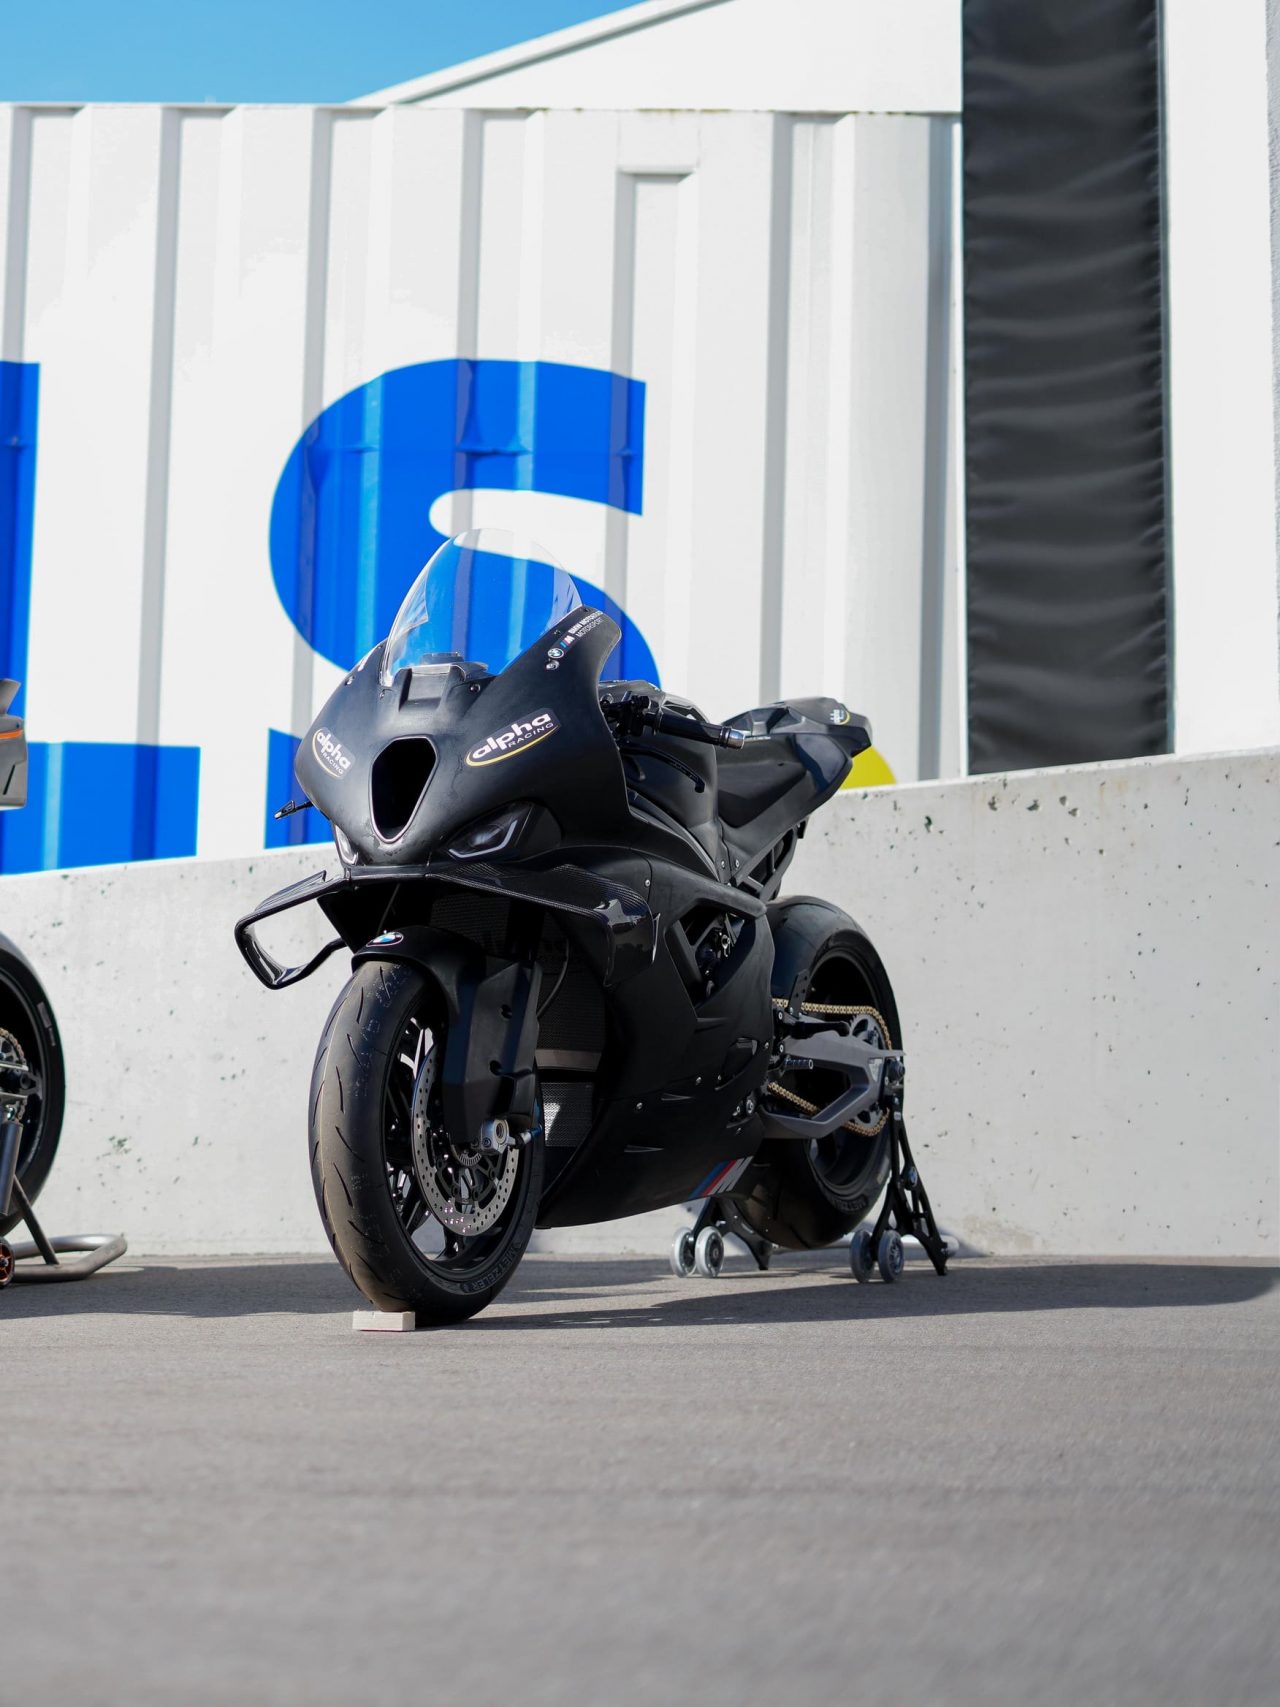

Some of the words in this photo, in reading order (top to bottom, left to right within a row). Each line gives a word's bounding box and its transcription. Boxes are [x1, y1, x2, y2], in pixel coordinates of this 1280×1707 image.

[315, 731, 352, 772] alpha
[472, 713, 552, 760] alpha
[507, 722, 555, 748] RACING
[320, 751, 345, 775] RACING
